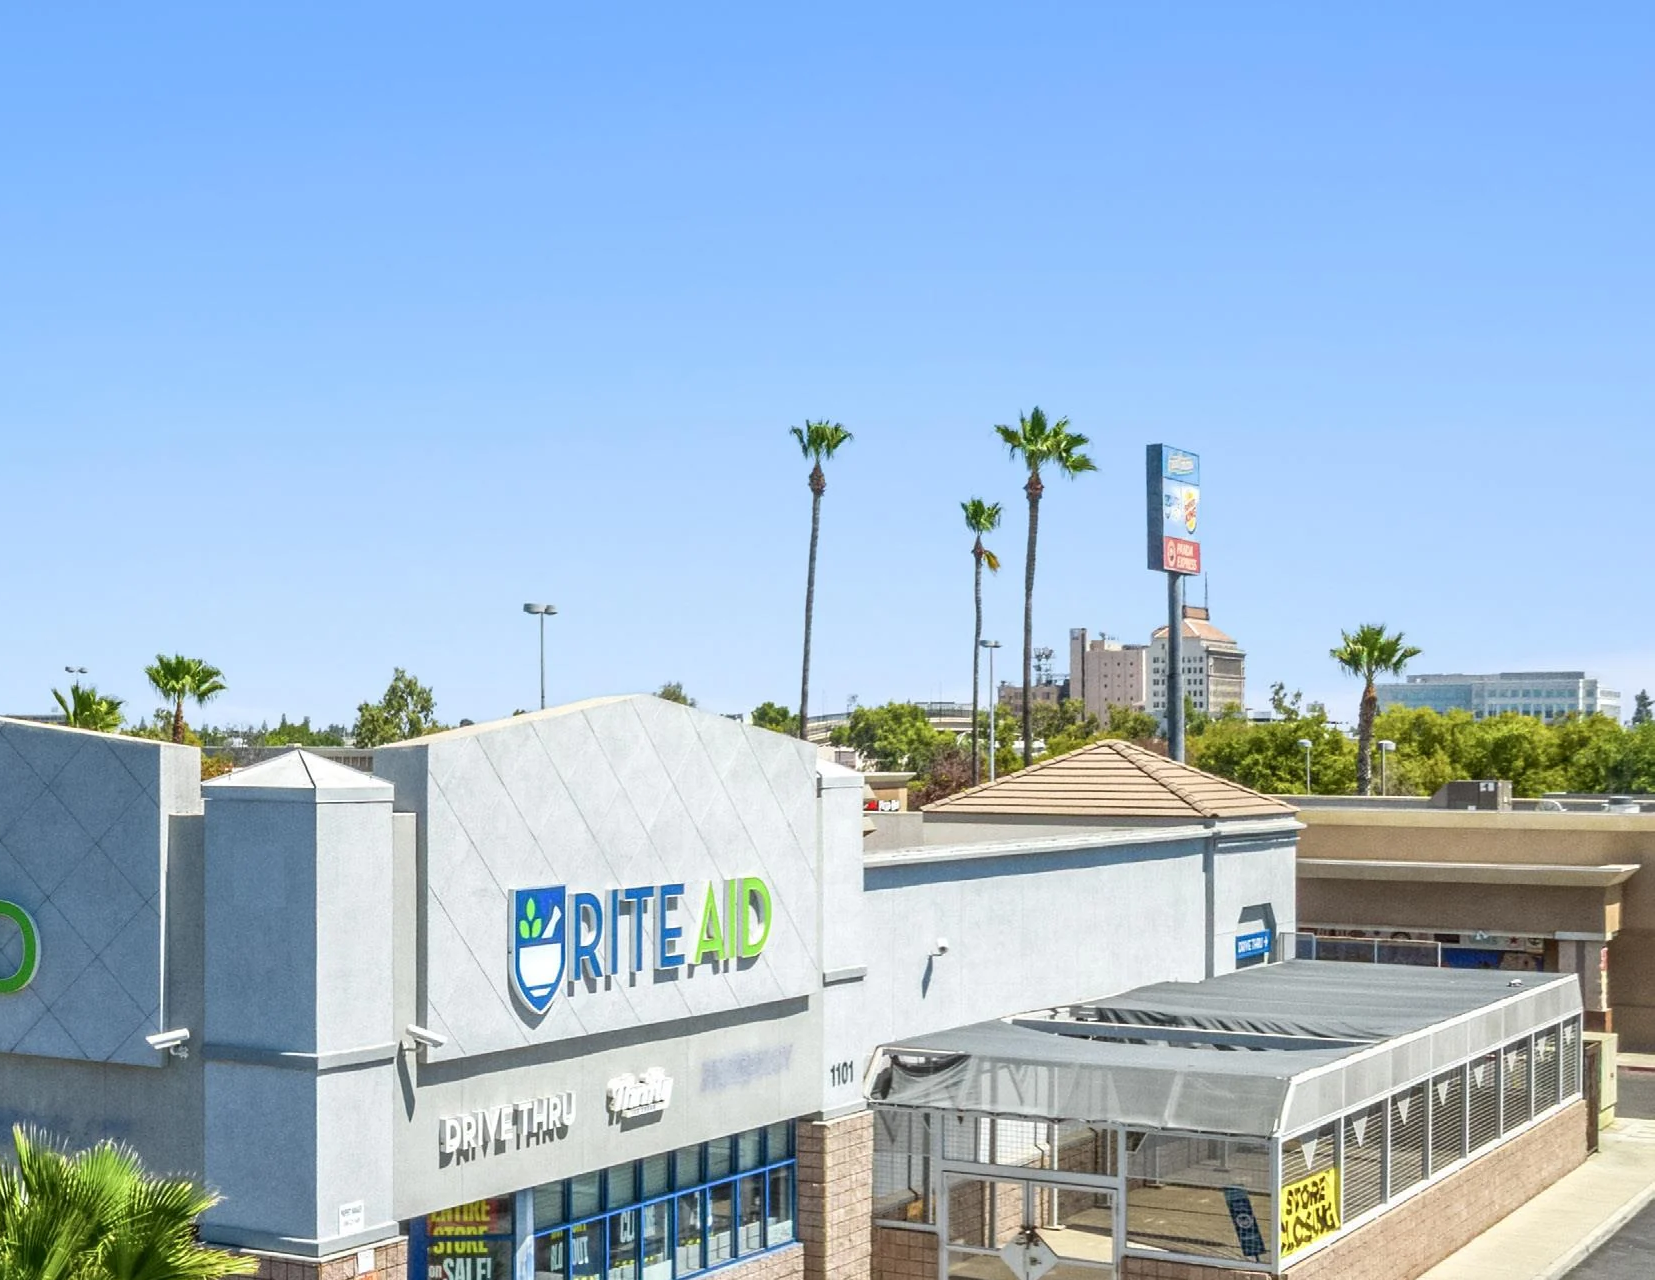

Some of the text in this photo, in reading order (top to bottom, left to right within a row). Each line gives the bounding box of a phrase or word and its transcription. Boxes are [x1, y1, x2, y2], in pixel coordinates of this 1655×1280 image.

[568, 876, 773, 981] RITE AID
[830, 1060, 854, 1087] 1101
[439, 1090, 576, 1154] DRIVE THRU
[1286, 1176, 1326, 1215] STORE
[433, 1226, 488, 1254] STORE
[428, 1265, 442, 1278] on
